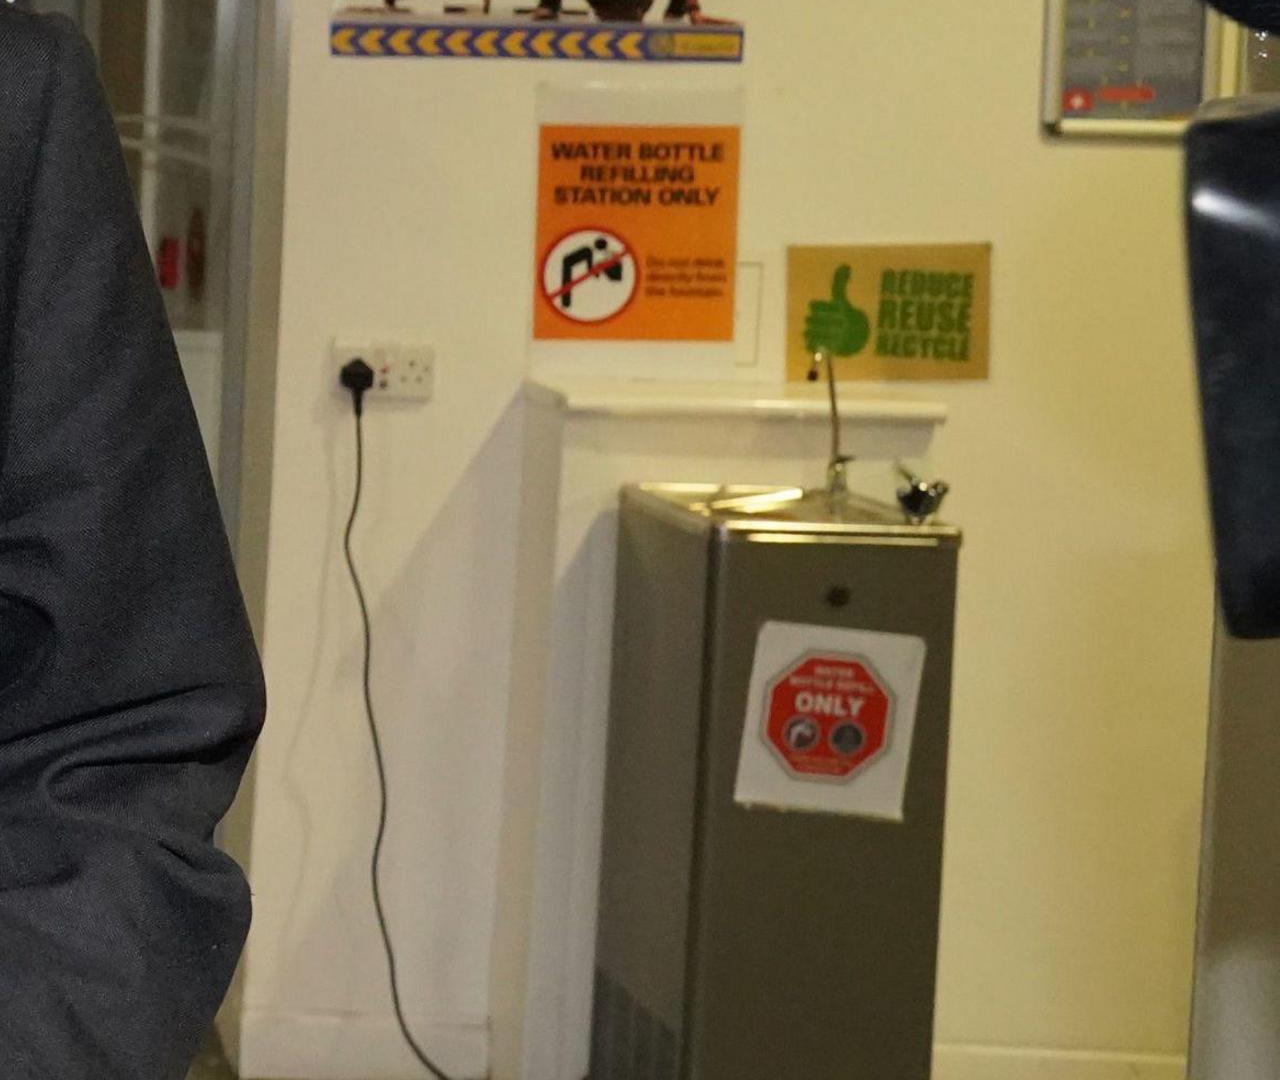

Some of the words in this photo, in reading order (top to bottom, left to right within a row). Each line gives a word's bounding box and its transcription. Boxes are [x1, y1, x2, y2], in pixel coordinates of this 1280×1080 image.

[552, 142, 632, 160] WATER
[638, 142, 724, 161] BOTTLE
[580, 165, 694, 183] REFILLING
[554, 186, 651, 206] STATION
[658, 187, 721, 207] ONLY
[881, 268, 975, 298] REDUCE
[878, 299, 971, 332] REUSE
[875, 333, 971, 362] RECYCLE
[795, 690, 865, 718] ONLY
